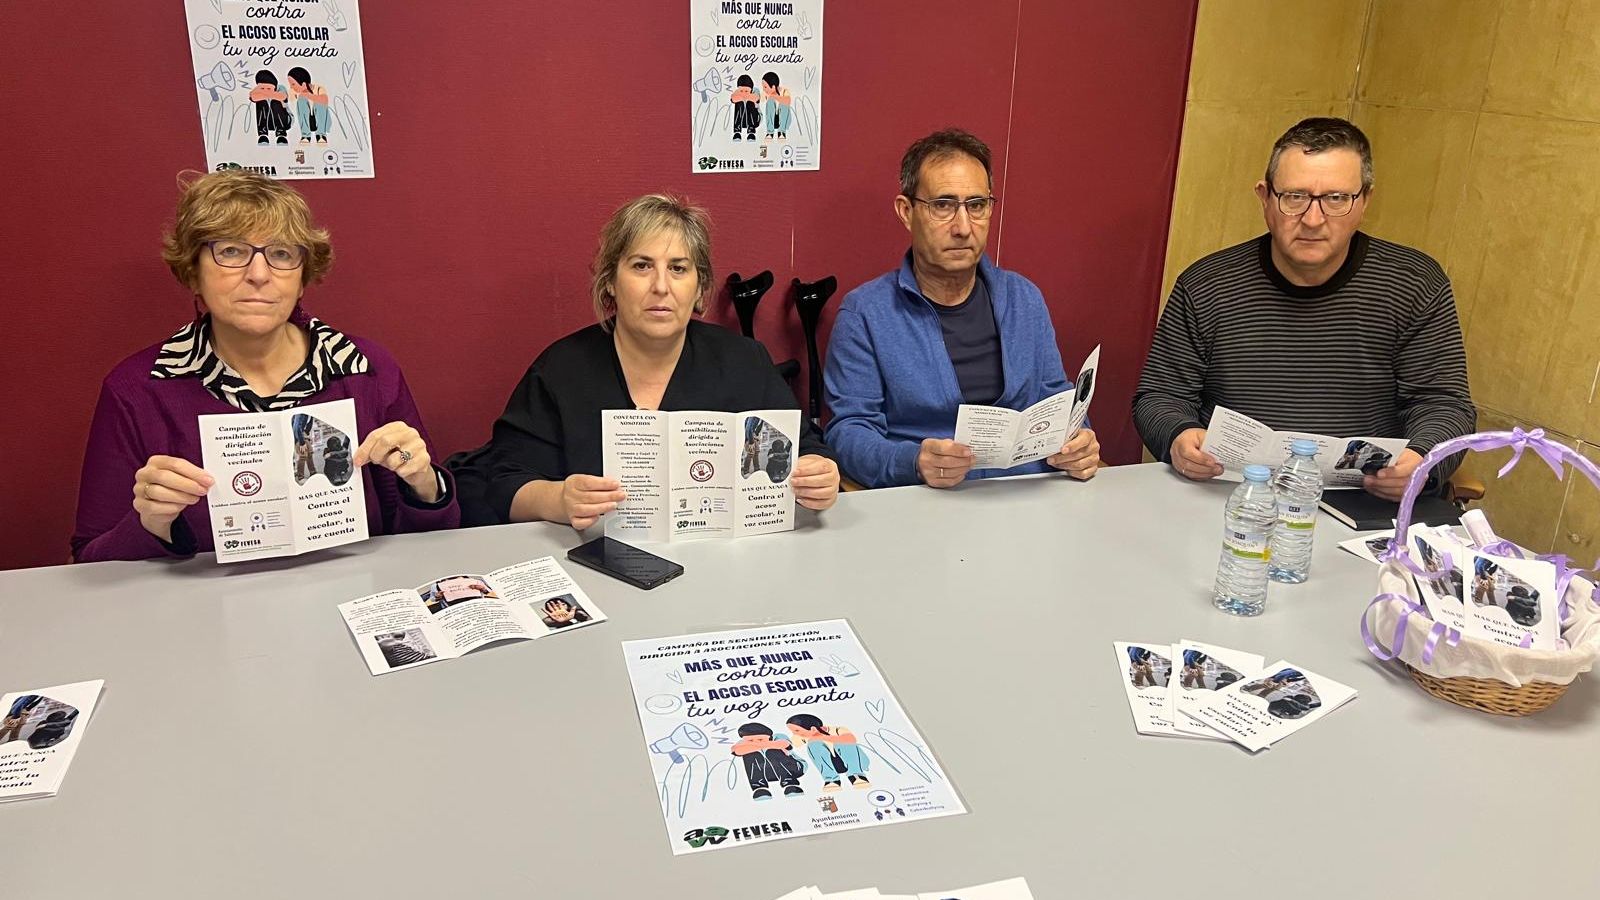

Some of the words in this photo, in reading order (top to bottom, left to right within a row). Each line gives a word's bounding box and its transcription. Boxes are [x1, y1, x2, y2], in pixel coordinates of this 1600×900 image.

[246, 2, 305, 19] contra
[722, 0, 742, 14] MÁS
[745, 2, 761, 15] QUE
[764, 3, 792, 15] NUNCA
[736, 14, 782, 29] contra
[222, 25, 235, 38] EL
[239, 25, 276, 39] ACOSO
[280, 26, 329, 40] ESCOLAR
[716, 35, 726, 47] EL
[729, 35, 758, 48] ACOSO
[760, 36, 798, 48] ESCOLAR
[223, 41, 242, 56] tu
[248, 46, 279, 65] voz
[285, 42, 338, 57] cuenta
[716, 49, 730, 63] tu
[734, 53, 758, 71] voz
[762, 50, 803, 63] cuenta
[719, 160, 744, 169] FEVESA
[215, 432, 272, 440] sensibilización
[308, 500, 339, 510] Contra
[318, 510, 342, 518] acoso
[325, 528, 354, 538] cuenta
[1484, 624, 1521, 640] Contra
[640, 650, 690, 660] DIRIGIDA
[704, 641, 781, 652] ASOCIACIONES
[784, 634, 842, 644] VECINALES
[658, 642, 708, 651] CAMPAÑA
[728, 630, 820, 644] SENSIBILIZACIÓN
[1494, 637, 1520, 647] acos
[684, 659, 722, 673] MÁS
[727, 656, 757, 668] QUE
[760, 650, 813, 664] NUNCA
[717, 663, 798, 682] contra
[683, 691, 708, 703] EL
[708, 683, 762, 700] ACOSO
[765, 676, 838, 694] ESCOLAR
[687, 703, 715, 718] tu
[724, 700, 769, 719] voz
[777, 688, 855, 707] cuenta
[1227, 702, 1258, 720] Contra
[1227, 710, 1252, 725] acoso
[1216, 718, 1247, 737] cuenta
[812, 813, 857, 823] Ayuntamiento
[824, 818, 860, 827] Salamanca
[732, 821, 792, 841] FEVESA
